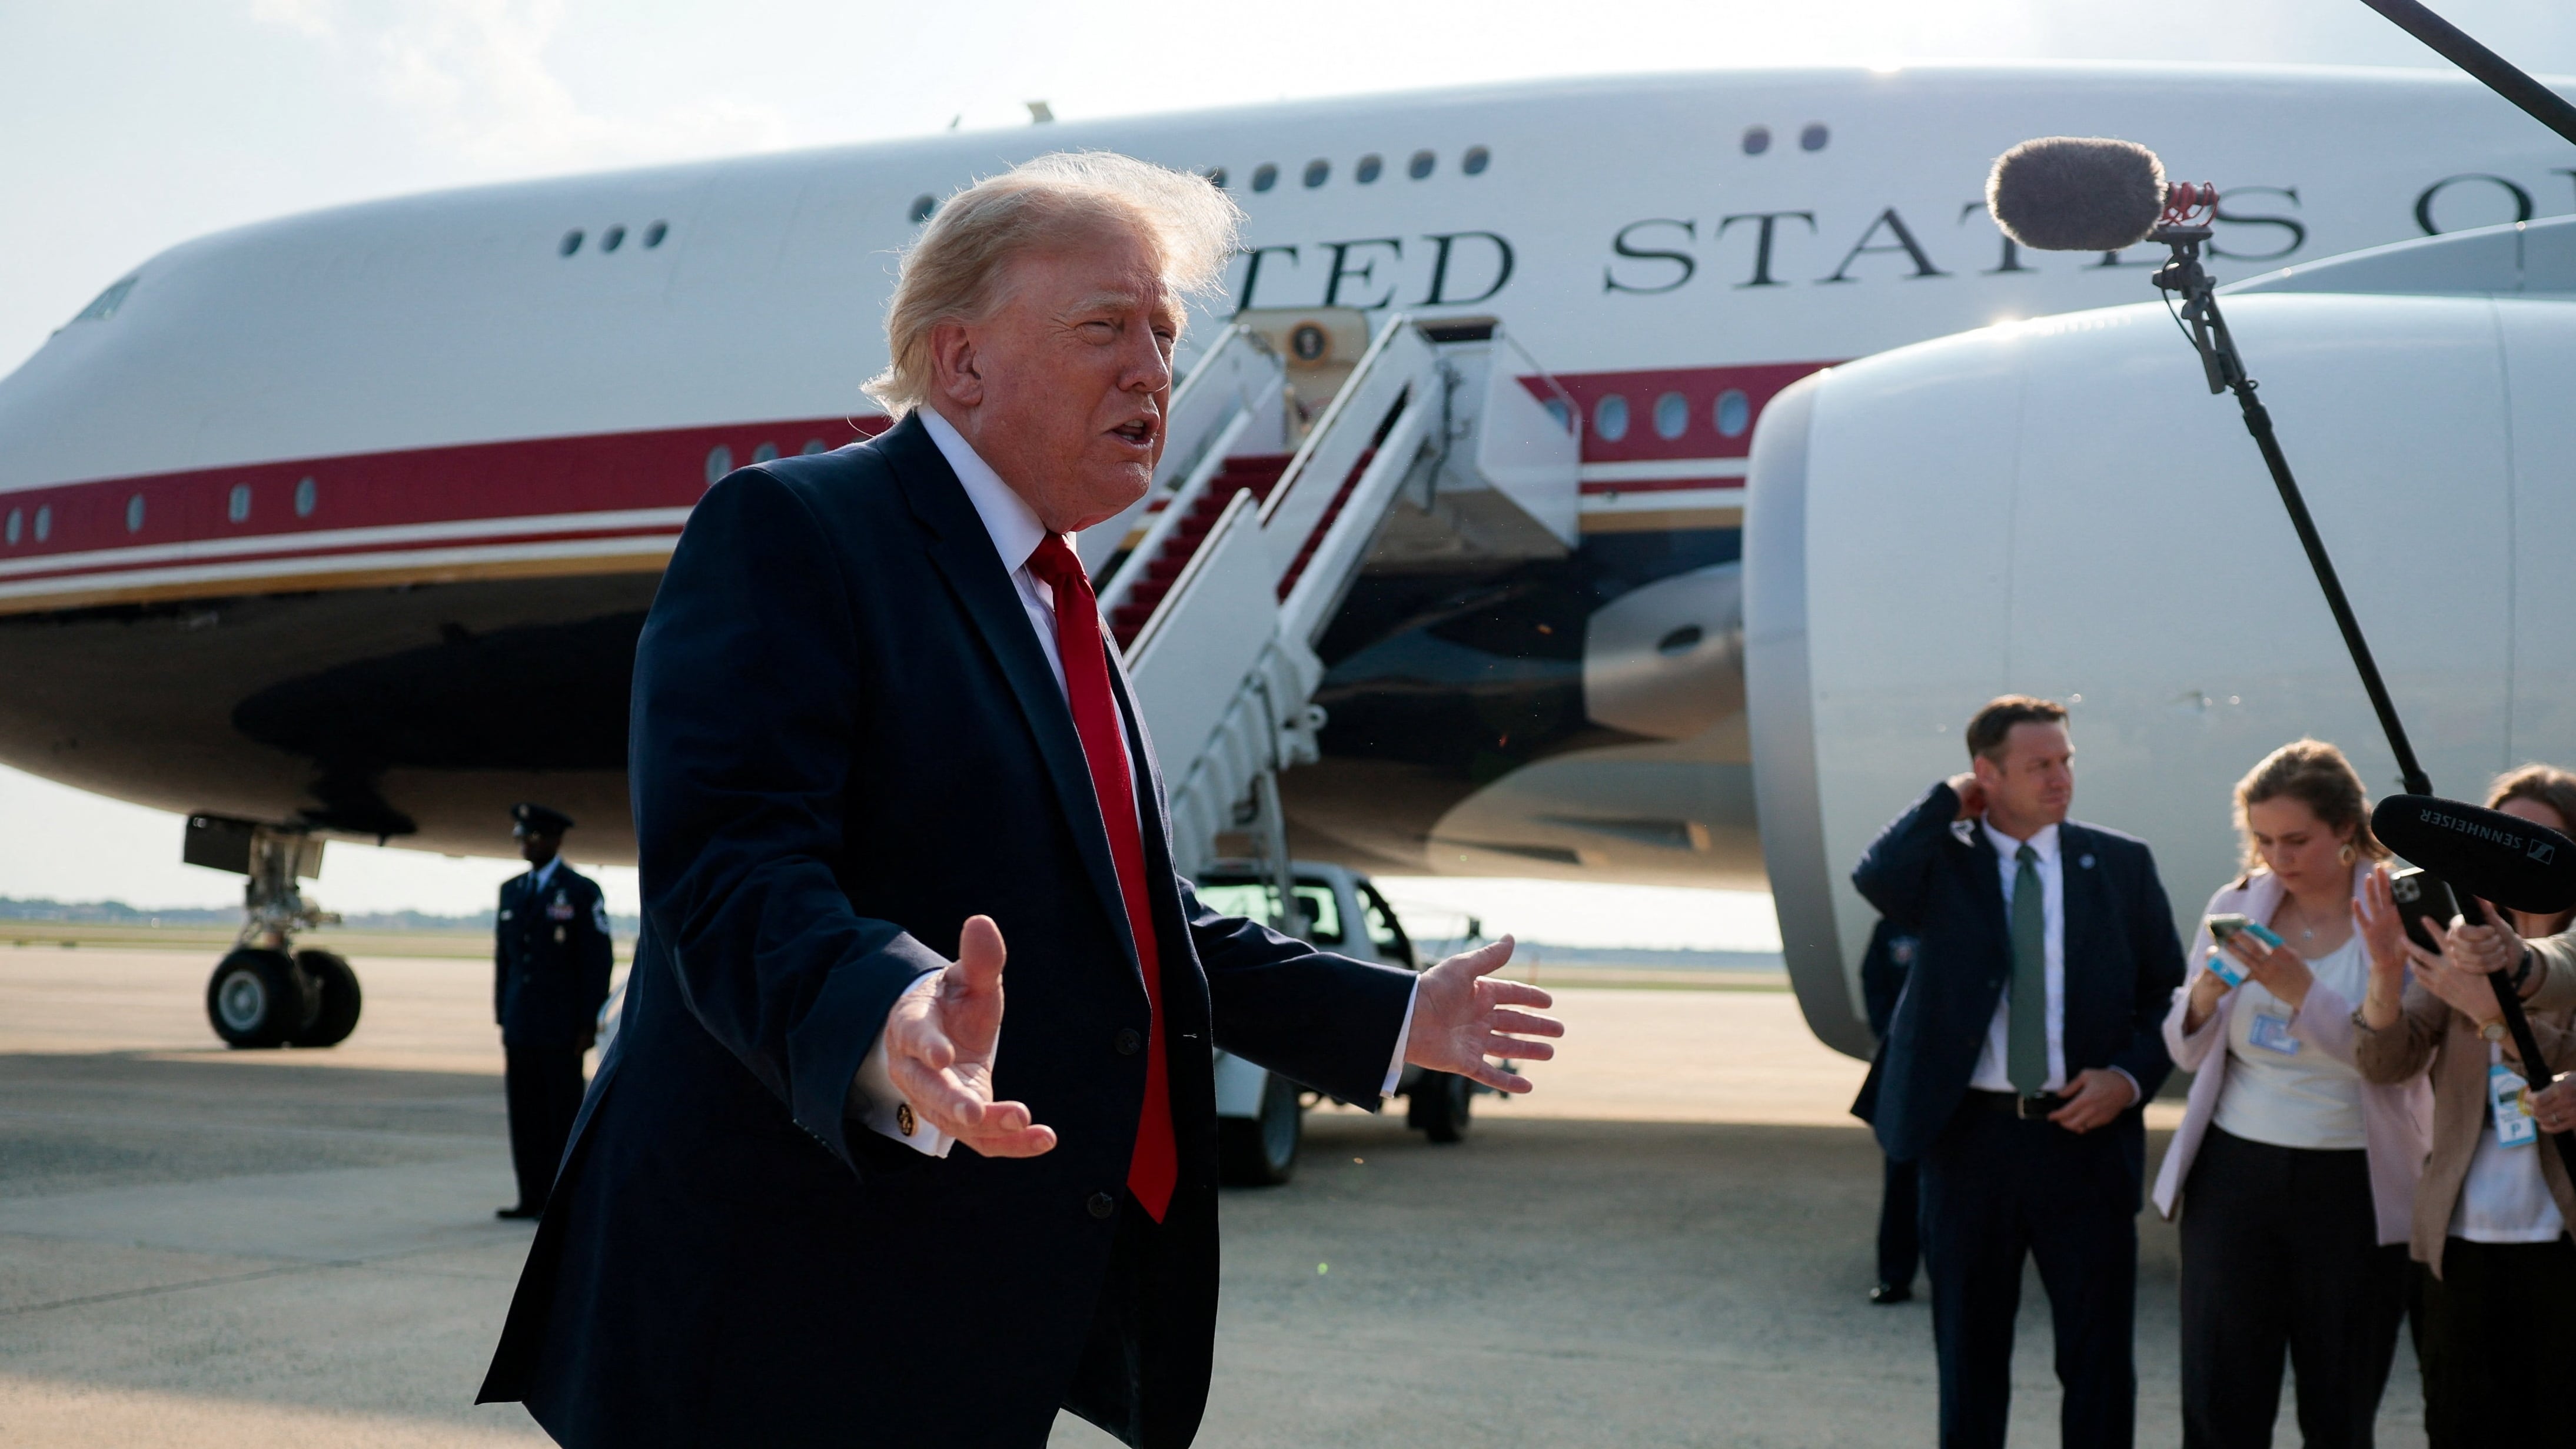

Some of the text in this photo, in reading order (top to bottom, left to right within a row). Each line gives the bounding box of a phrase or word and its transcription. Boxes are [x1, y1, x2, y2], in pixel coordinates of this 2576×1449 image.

[1217, 230, 1514, 321] TED
[1603, 185, 2306, 295] STAS
[2420, 809, 2523, 849] SENNHEISER
